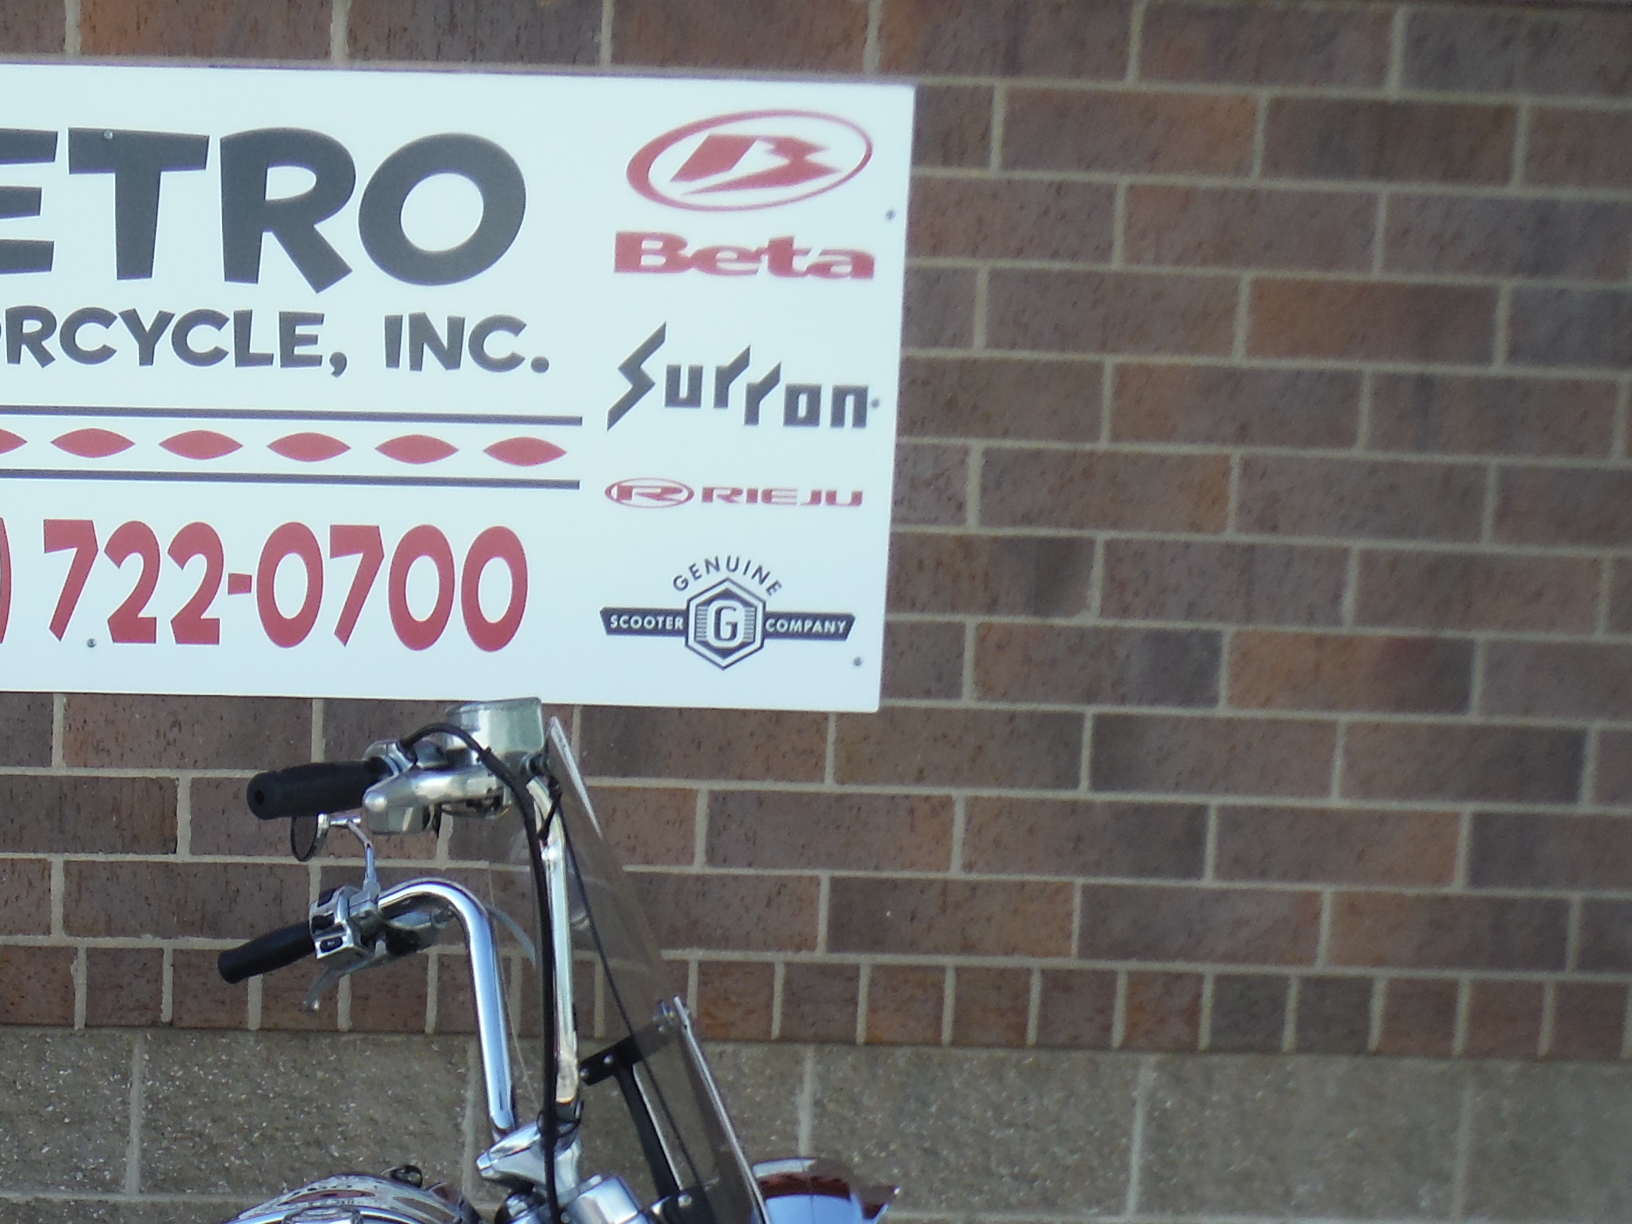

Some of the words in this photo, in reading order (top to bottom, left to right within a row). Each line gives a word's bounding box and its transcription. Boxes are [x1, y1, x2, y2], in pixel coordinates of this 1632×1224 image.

[614, 231, 875, 280] Beta
[383, 312, 550, 374] INC.
[607, 321, 868, 431] Surron
[701, 486, 864, 507] RIEJU
[42, 519, 529, 652] 722-0700
[672, 555, 783, 597] GENUINE
[609, 615, 684, 629] SCOOTER
[714, 605, 738, 641] G
[765, 618, 847, 634] COMPANY
